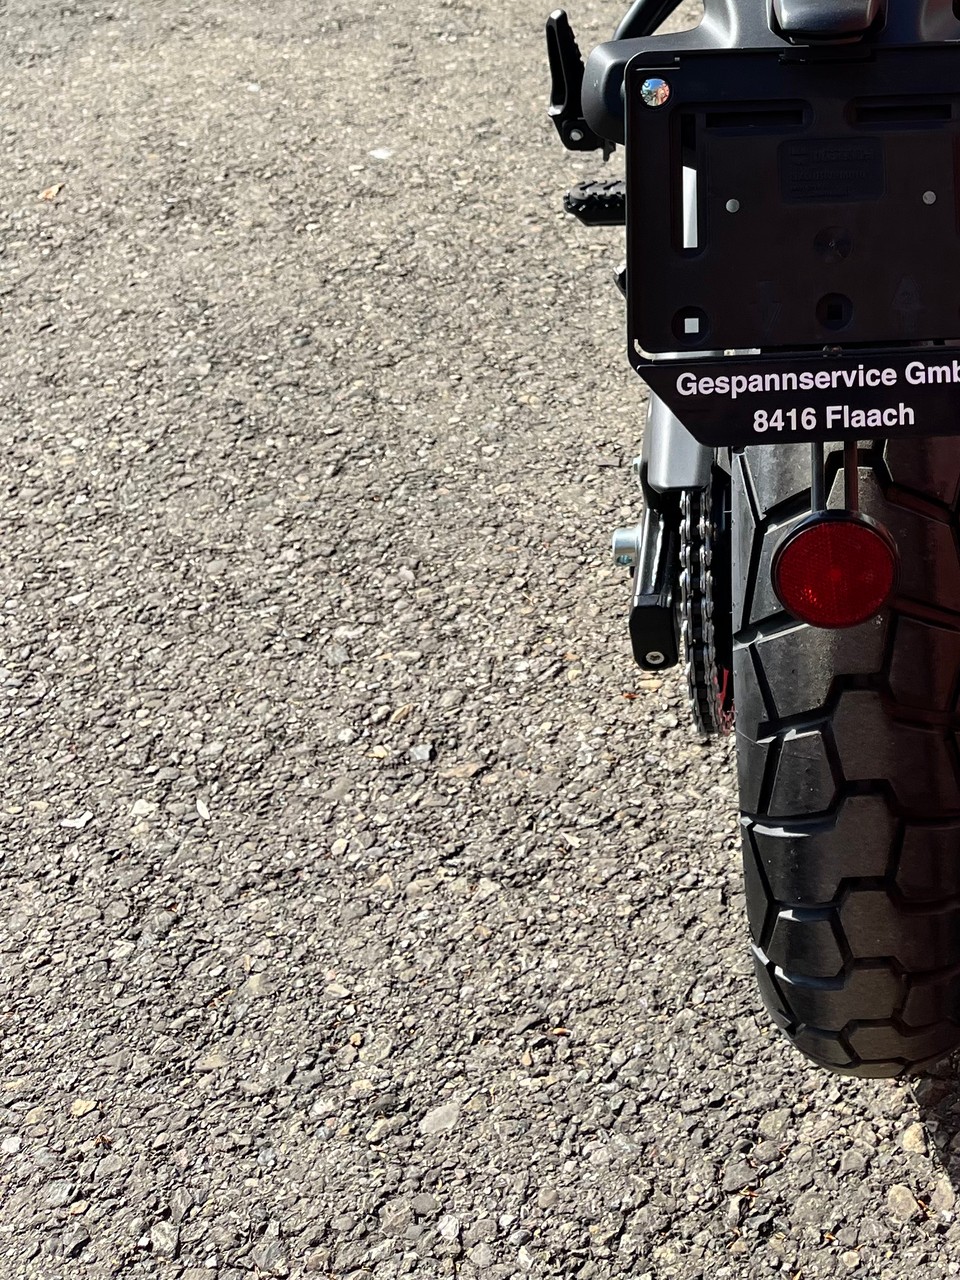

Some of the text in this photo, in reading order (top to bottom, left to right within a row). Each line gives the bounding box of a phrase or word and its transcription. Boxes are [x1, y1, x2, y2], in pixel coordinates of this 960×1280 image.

[676, 365, 897, 399] Gespannservice
[752, 403, 915, 432] 8416 Flaach
